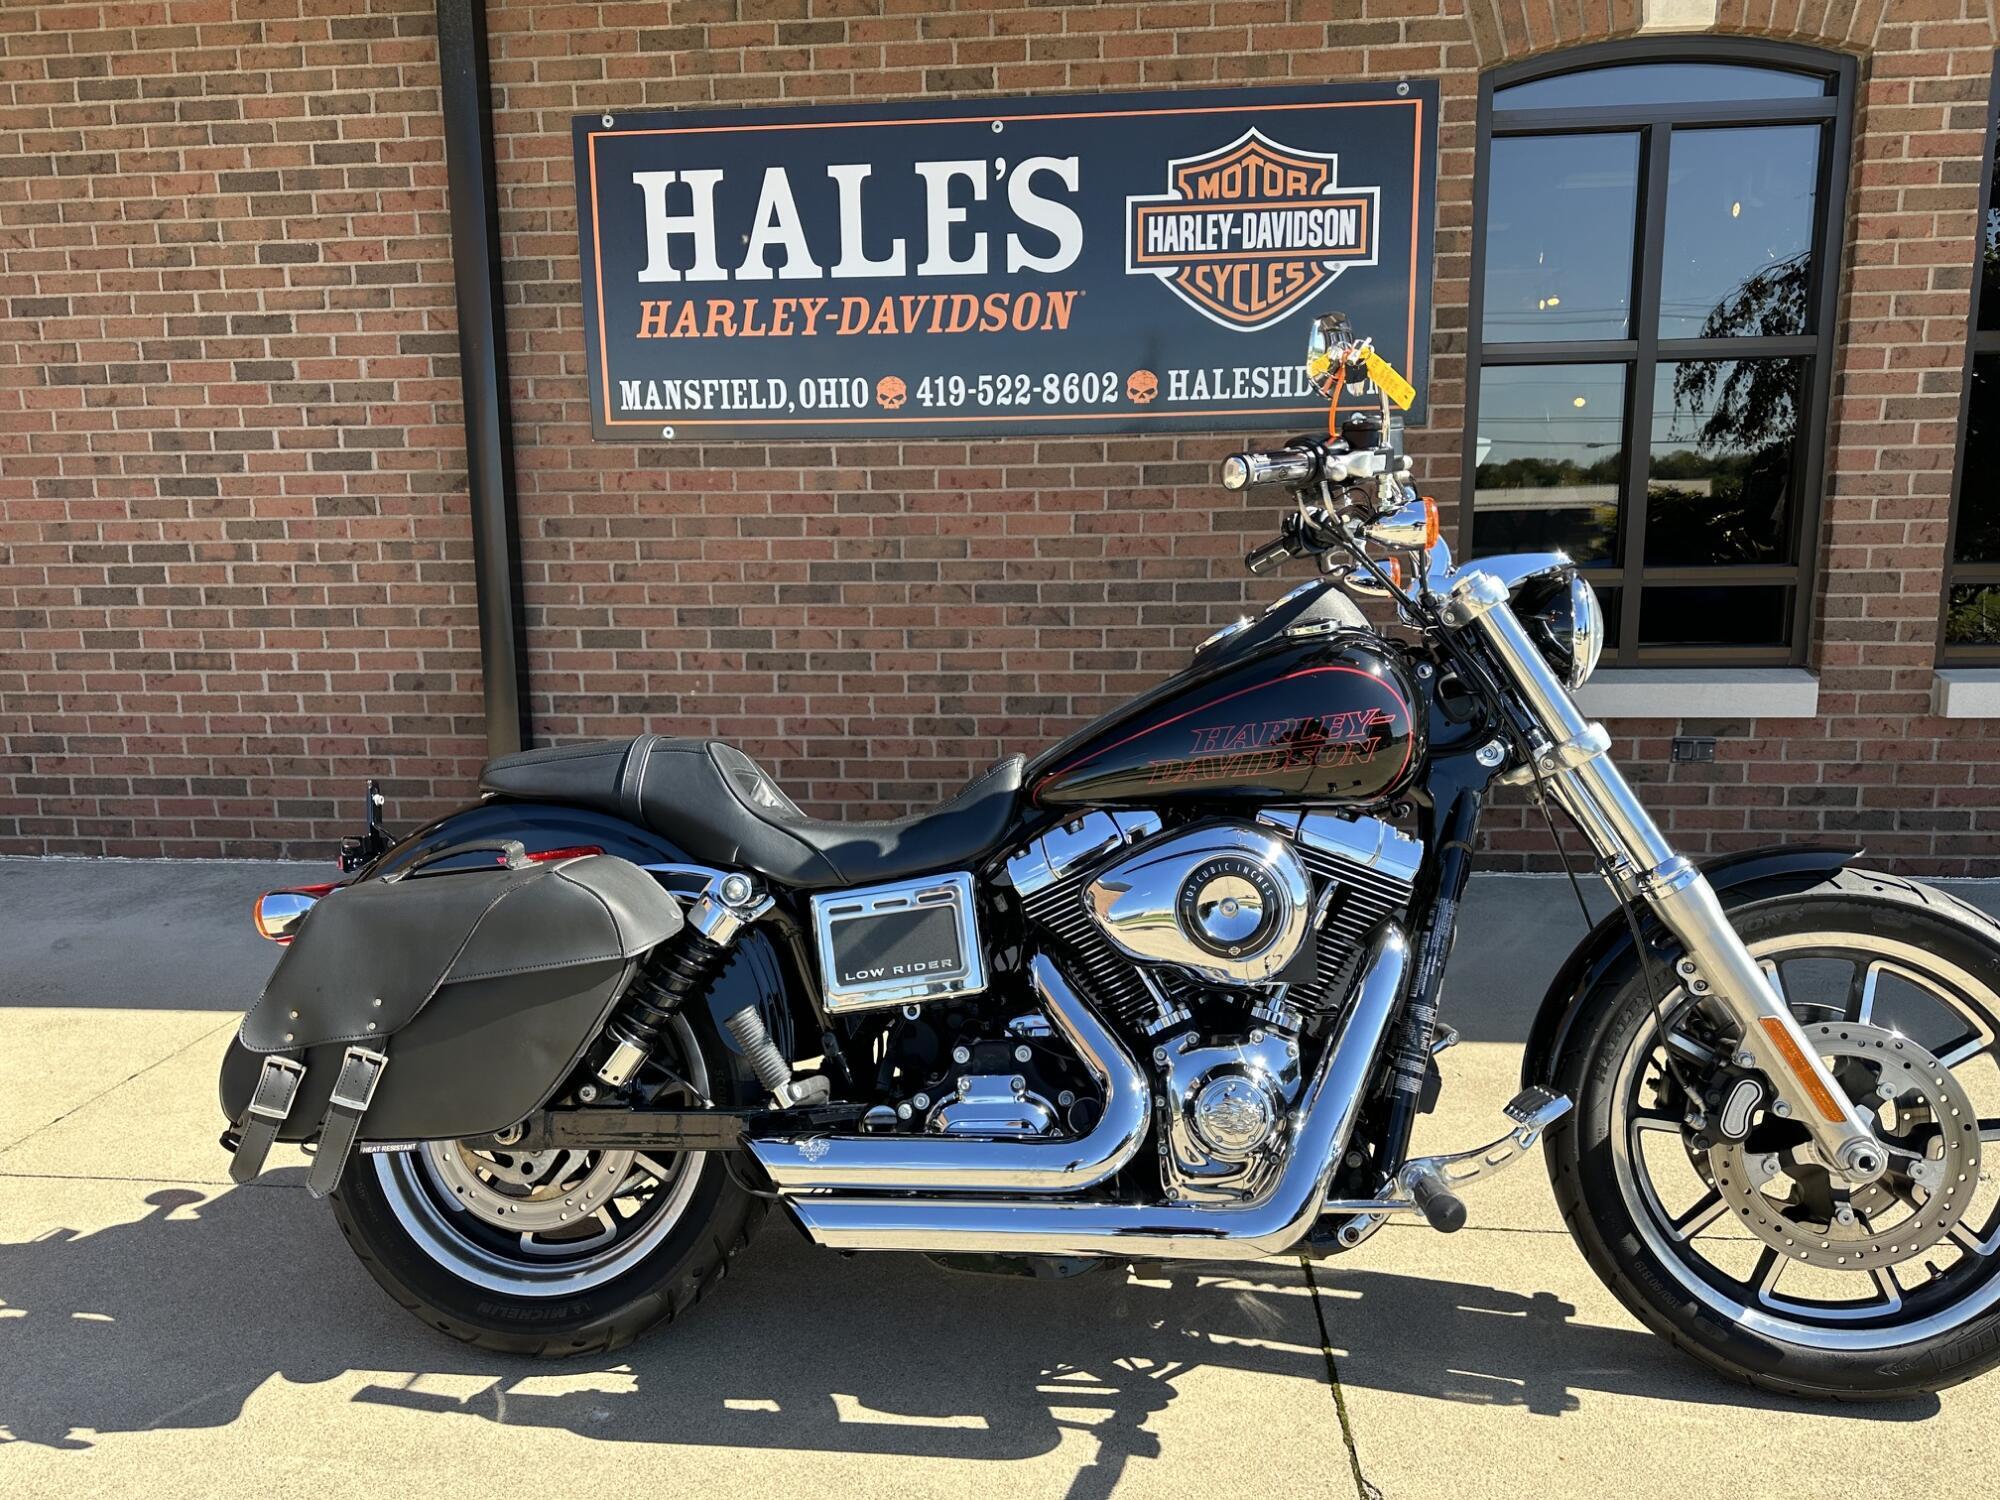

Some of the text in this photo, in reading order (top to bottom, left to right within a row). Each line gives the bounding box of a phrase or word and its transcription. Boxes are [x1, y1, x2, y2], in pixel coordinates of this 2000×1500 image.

[1198, 154, 1308, 199] MOTOR
[632, 156, 1084, 283] HALE'S
[1148, 208, 1356, 253] HARLEY-DAVIDSON
[1195, 261, 1305, 312] CYCLES
[636, 290, 1079, 339] HARLEY-DAVIDSON
[916, 371, 1119, 407] 419-522-8602
[1147, 736, 1381, 785] DAVIDSON
[1184, 863, 1274, 902] 103 CUBIC INCHES
[845, 959, 953, 981] LOW RIDER
[361, 1143, 417, 1154] HEAT RESISTANT
[478, 1301, 568, 1321] MICHELIN
